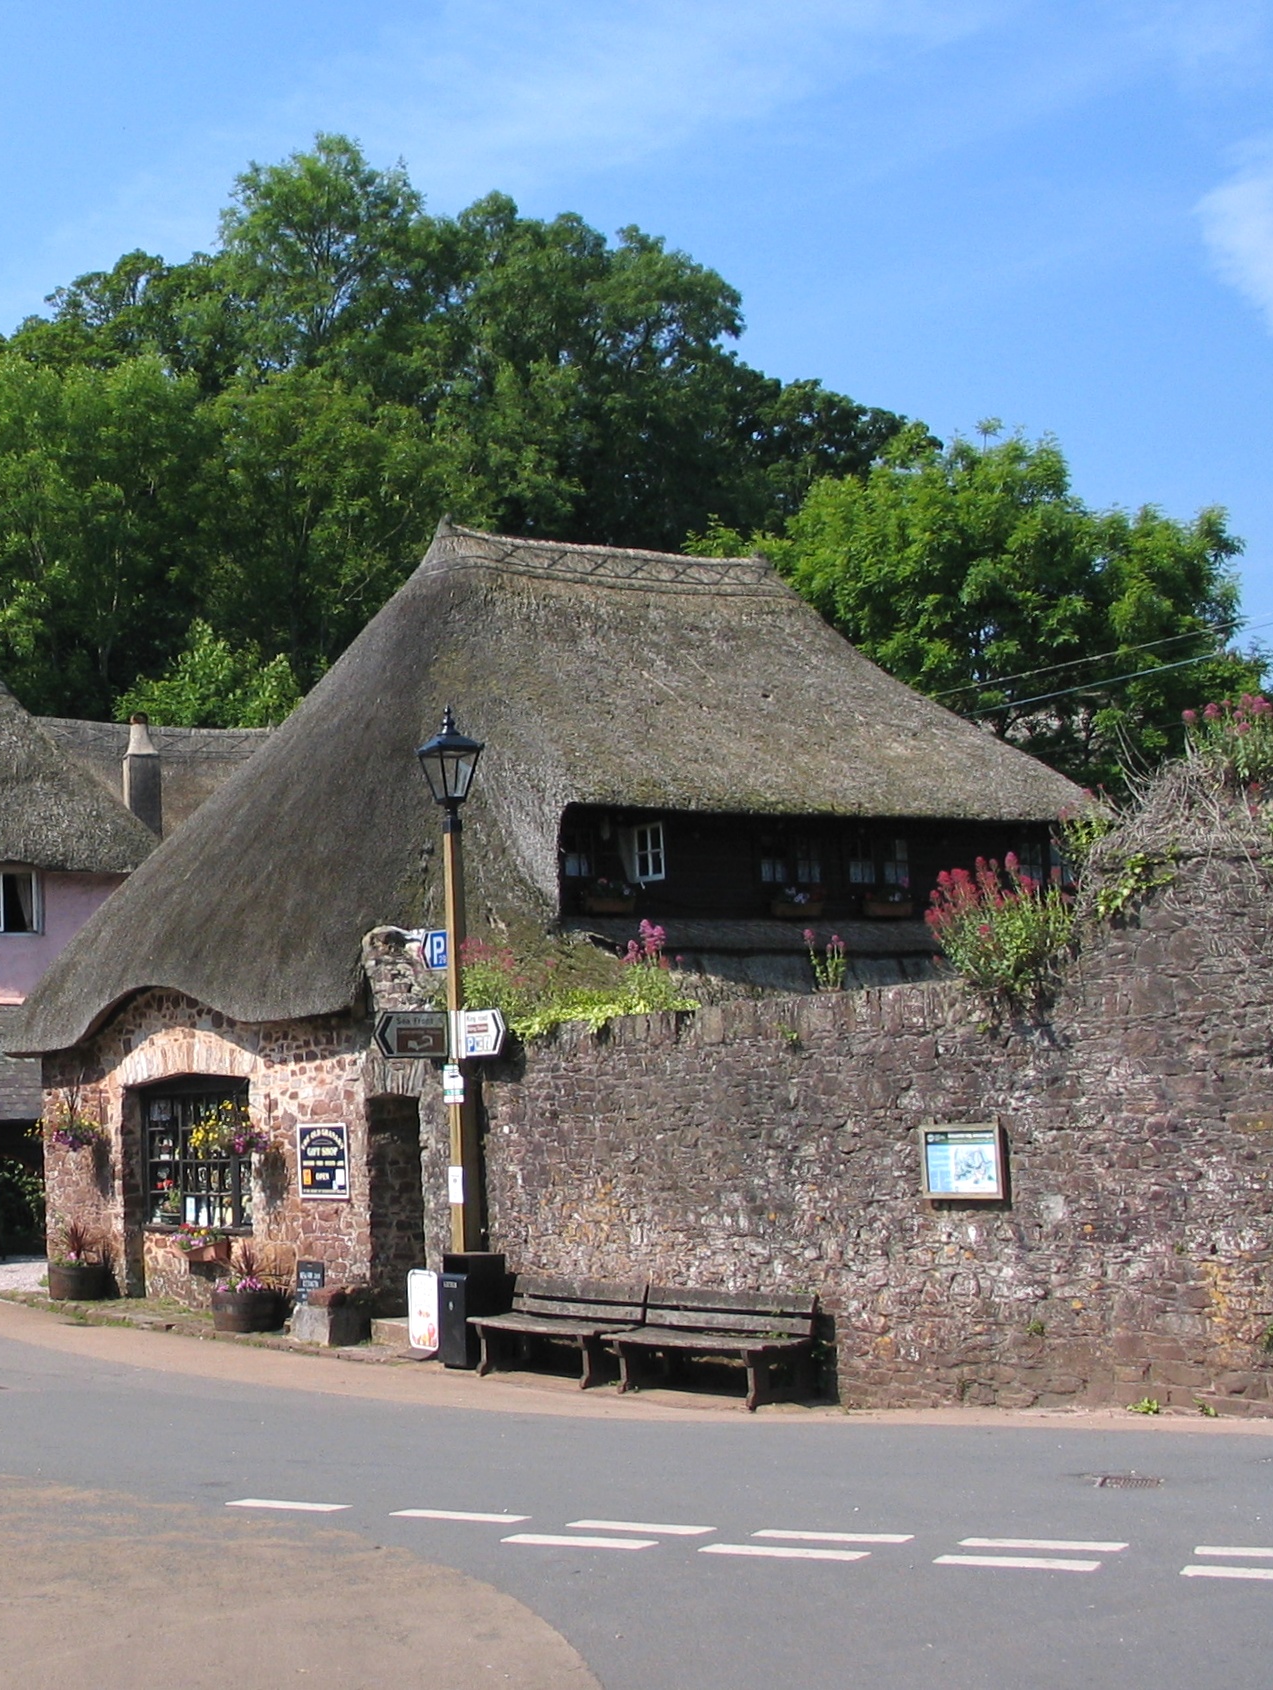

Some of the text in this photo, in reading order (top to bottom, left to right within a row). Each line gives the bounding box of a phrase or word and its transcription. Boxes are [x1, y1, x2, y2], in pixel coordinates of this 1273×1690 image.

[432, 936, 445, 965] P
[396, 1016, 434, 1025] Sea Front
[306, 1146, 339, 1157] GIFT SHOP
[315, 1172, 330, 1181] OPEN
